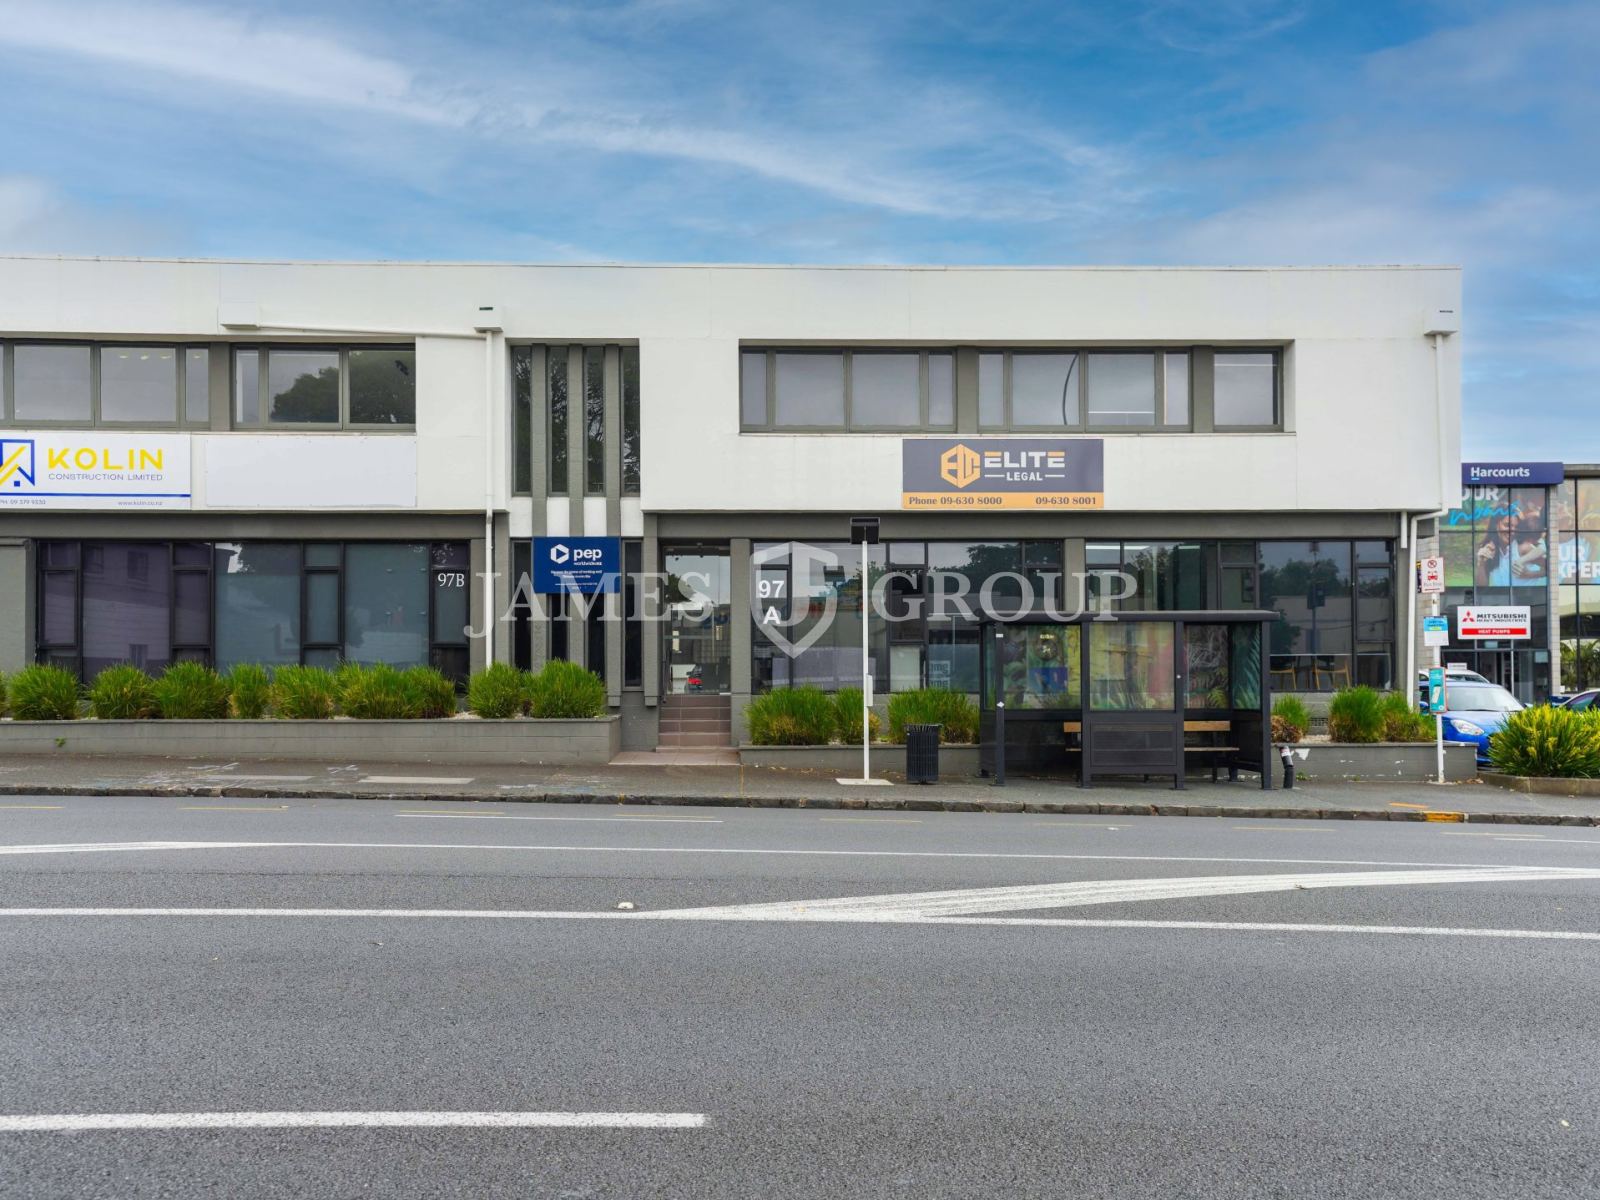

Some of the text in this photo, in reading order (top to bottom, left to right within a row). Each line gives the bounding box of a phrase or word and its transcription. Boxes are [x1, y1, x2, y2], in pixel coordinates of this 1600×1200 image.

[48, 447, 163, 470] KOLIN
[984, 451, 1066, 468] ELITE
[48, 473, 163, 481] CONSTRUCTION LIMITED
[1006, 472, 1043, 481] LEGAL
[1470, 467, 1530, 478] Harcourts
[908, 496, 1003, 506] Phone 09-630 8000
[1035, 496, 1097, 506] 09-630 8001
[573, 548, 603, 562] pep
[437, 573, 465, 588] 97B
[757, 579, 785, 599] 97
[762, 606, 781, 625] A
